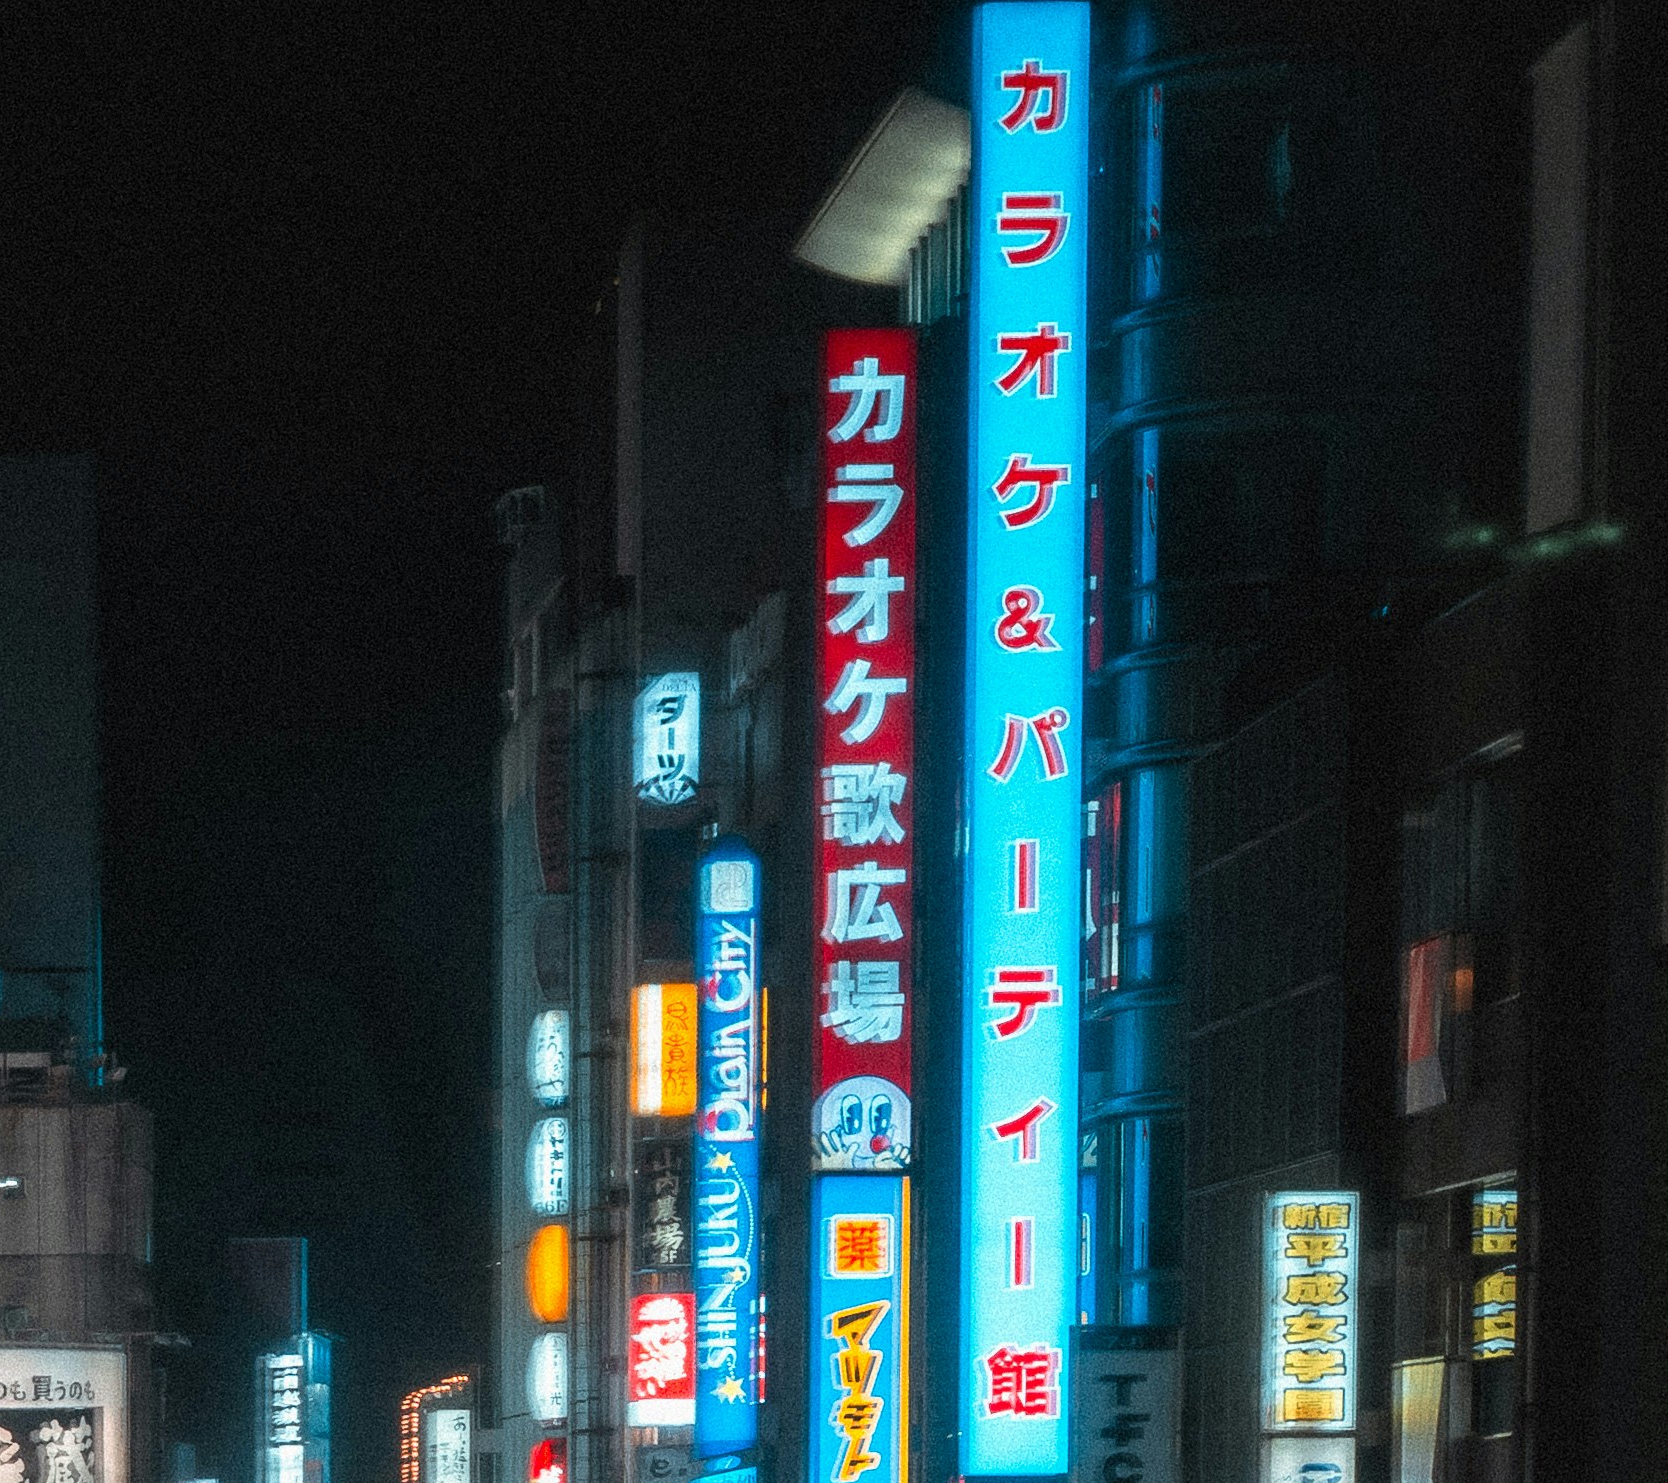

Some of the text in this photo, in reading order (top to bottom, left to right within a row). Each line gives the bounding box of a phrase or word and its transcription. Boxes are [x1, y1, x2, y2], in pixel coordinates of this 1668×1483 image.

[821, 355, 909, 1045] カラオケ歌広場
[983, 58, 1073, 1420] カラオケ&パーティー館
[835, 1220, 888, 1274] 薬
[1282, 1202, 1352, 1229] 新宿
